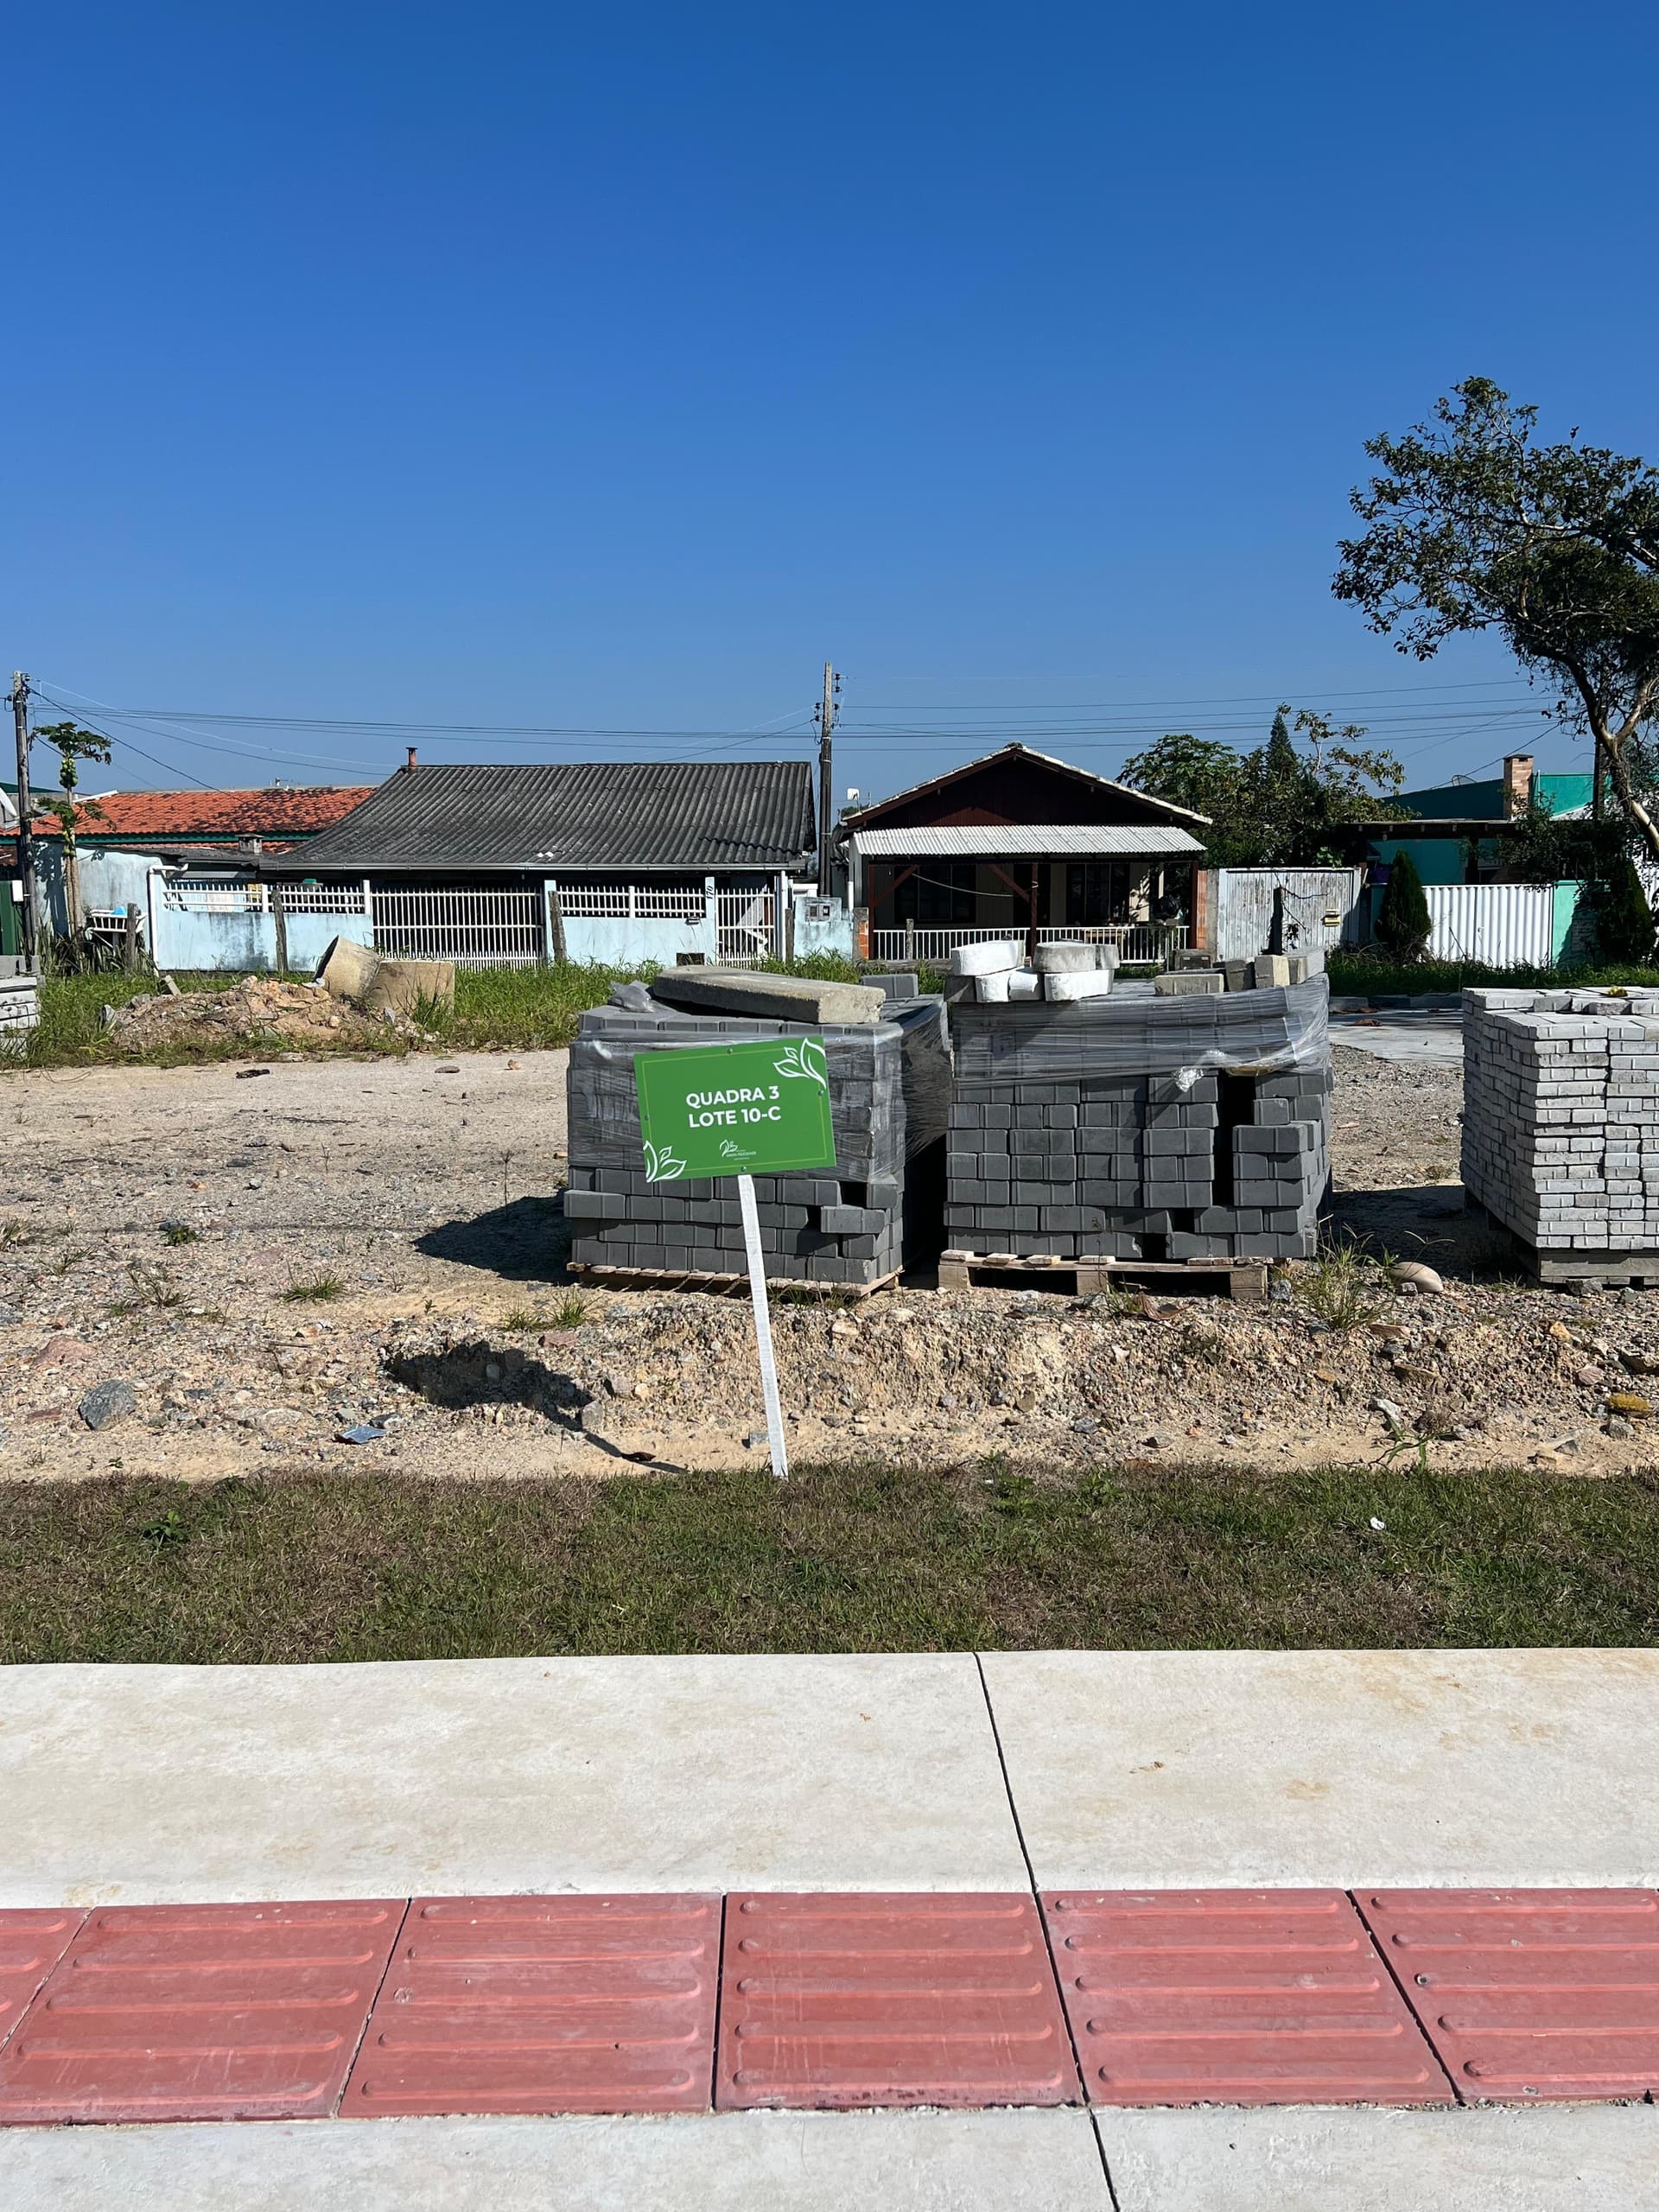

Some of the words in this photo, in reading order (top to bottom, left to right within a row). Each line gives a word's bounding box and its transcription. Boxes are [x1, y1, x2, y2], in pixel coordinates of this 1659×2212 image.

[685, 1087, 766, 1109] QUADRA
[768, 1085, 780, 1100] 3
[689, 1109, 738, 1128] LOTE
[741, 1105, 782, 1124] 10-C
